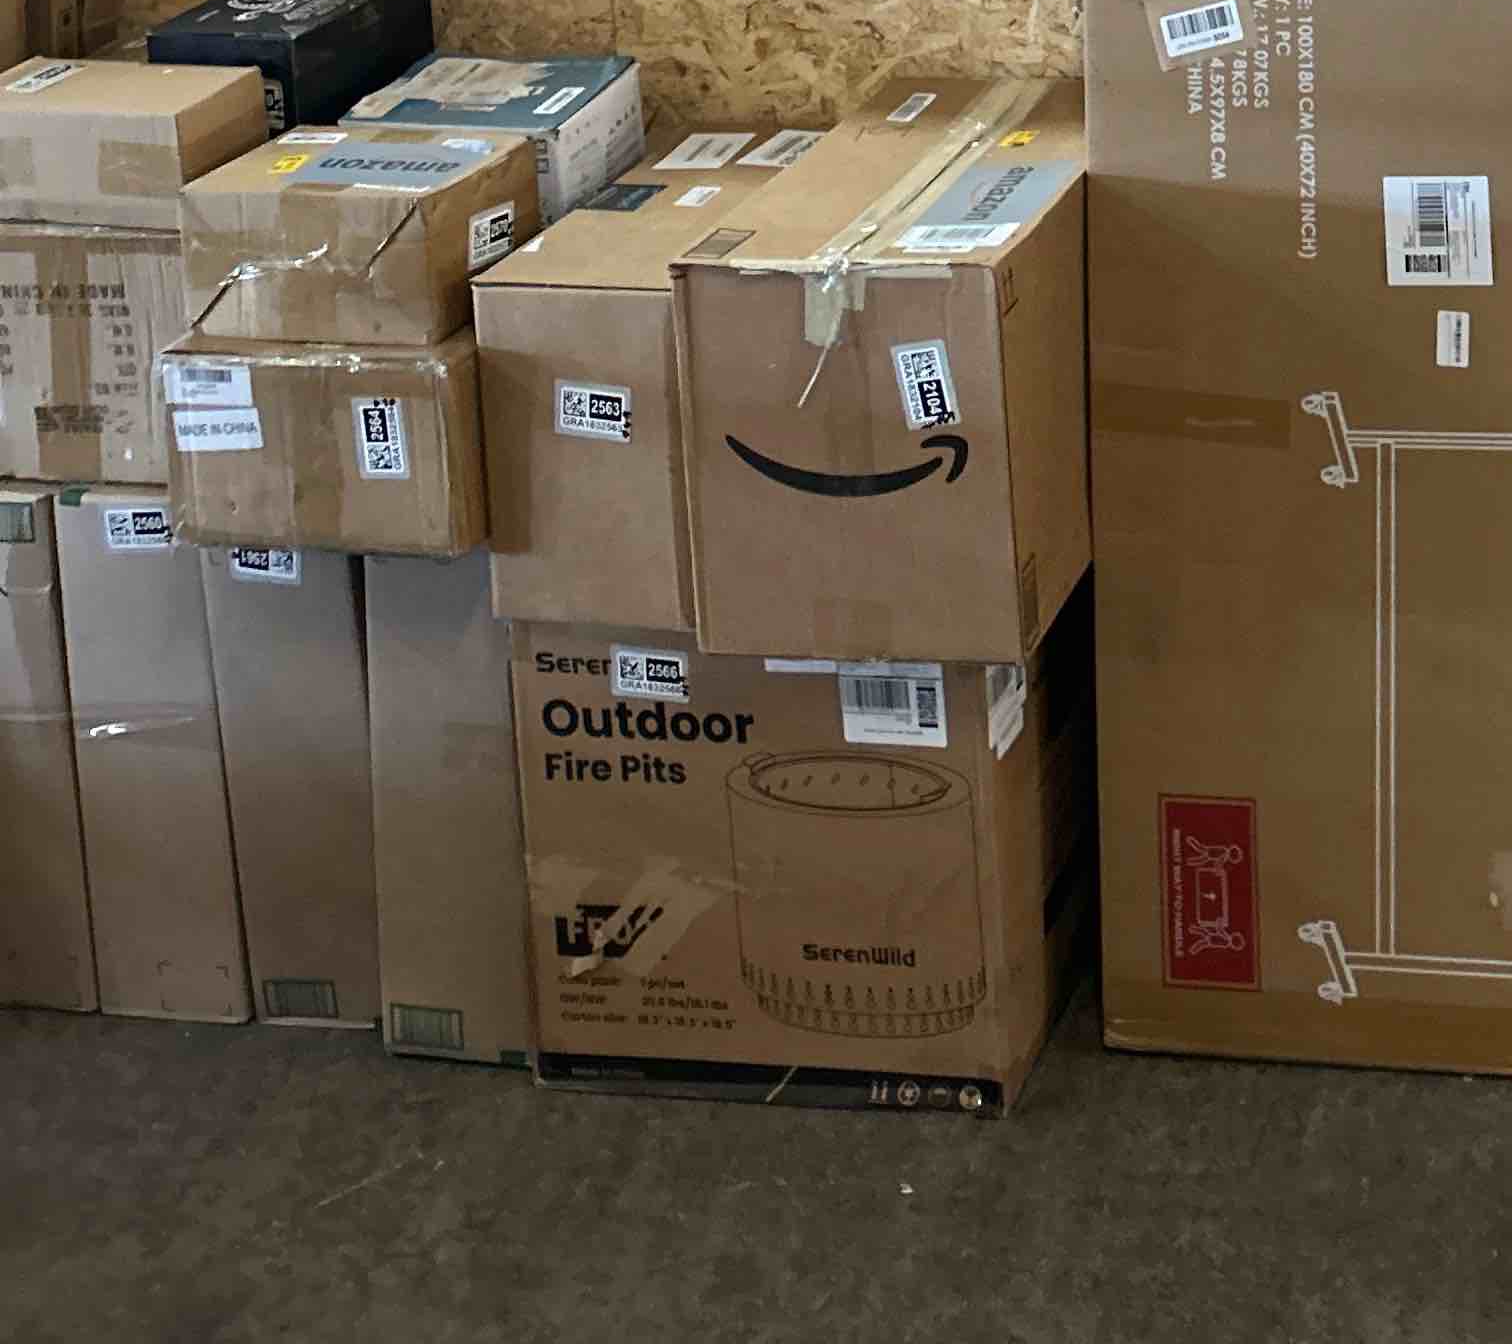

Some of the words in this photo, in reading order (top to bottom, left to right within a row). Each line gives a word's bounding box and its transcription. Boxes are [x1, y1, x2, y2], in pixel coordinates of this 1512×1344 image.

[1275, 16, 1291, 24] 1
[1276, 30, 1291, 57] PC
[1297, 15, 1314, 93] 100X180
[1187, 62, 1204, 114] HINA
[1298, 97, 1315, 129] CM
[319, 155, 461, 175] amazon
[1210, 146, 1227, 180] CM
[1296, 134, 1316, 198] (40X72
[964, 166, 1035, 223] amazon
[1298, 202, 1318, 259] INCH)
[0, 282, 44, 300] CHIN
[591, 399, 620, 417] 2563
[920, 380, 943, 417] 2104
[178, 421, 209, 437] MADE
[222, 420, 258, 435] CHINA
[367, 410, 385, 442] 2564
[647, 663, 679, 680] 2566
[542, 698, 755, 745] Outdoor
[544, 753, 613, 784] Fire
[621, 754, 687, 785] Pits
[1173, 864, 1183, 893] WAY
[802, 942, 916, 969] SerenWild
